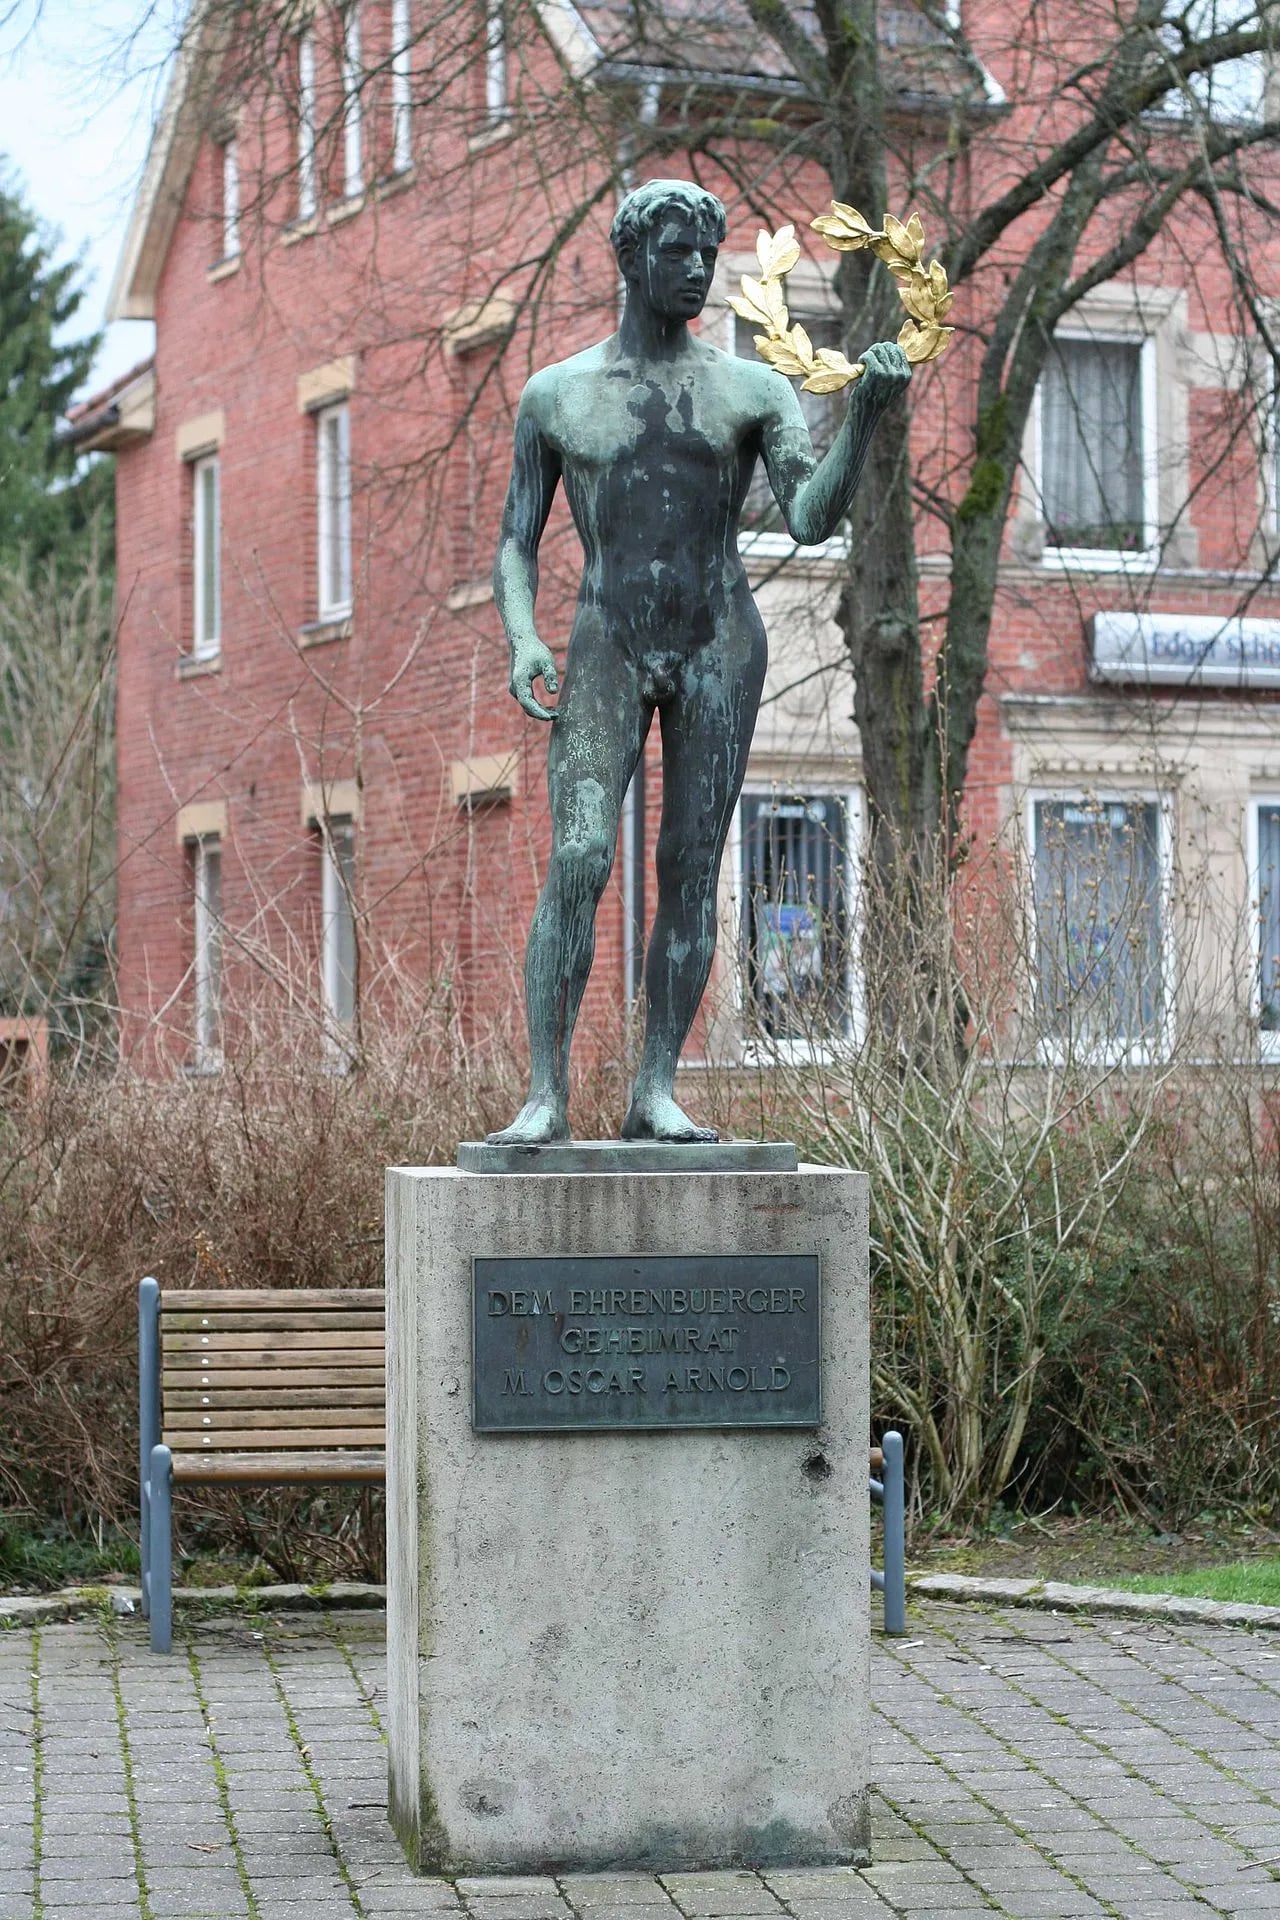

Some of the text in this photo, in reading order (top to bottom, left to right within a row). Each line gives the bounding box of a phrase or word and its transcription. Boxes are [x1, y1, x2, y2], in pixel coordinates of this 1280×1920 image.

[488, 1288, 808, 1316] DEM EHRENBUERGER
[561, 1328, 740, 1354] GEHEIMRAT
[502, 1366, 792, 1395] M. OSCAR ARNOLD
